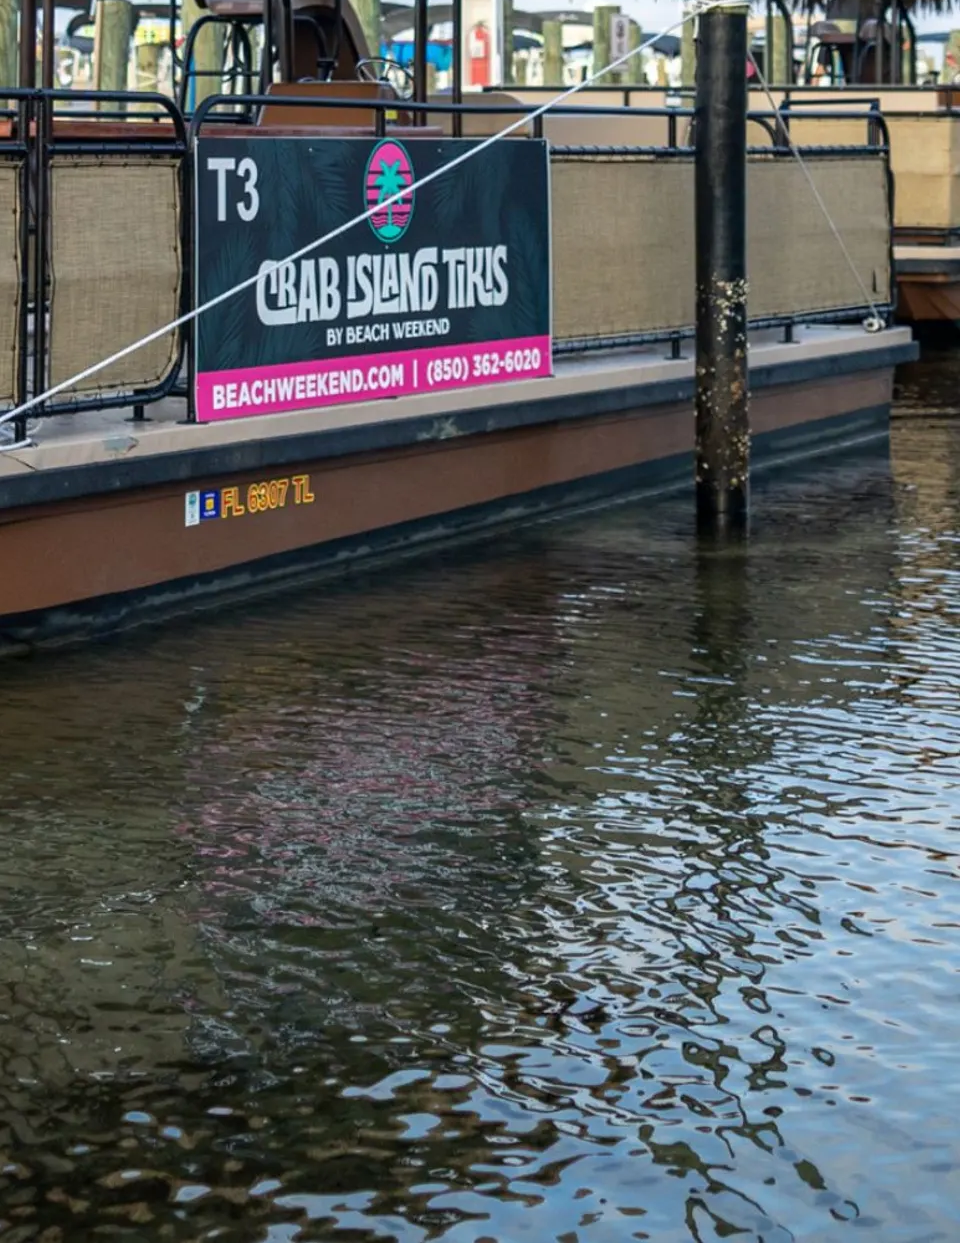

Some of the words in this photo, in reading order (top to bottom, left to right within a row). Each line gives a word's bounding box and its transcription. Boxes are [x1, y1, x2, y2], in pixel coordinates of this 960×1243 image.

[207, 157, 260, 221] T3
[256, 257, 341, 326] CRAB
[346, 246, 439, 319] ISLAND
[442, 244, 509, 309] TIKIS
[326, 327, 344, 346] BY
[345, 322, 390, 345] BEACH
[391, 317, 450, 339] WEEKEND
[212, 363, 405, 410] BEACHWEEKEND.COM
[426, 356, 469, 386] (850)
[472, 347, 541, 377] 362-6020
[221, 486, 245, 519] FL
[292, 473, 315, 504] TL
